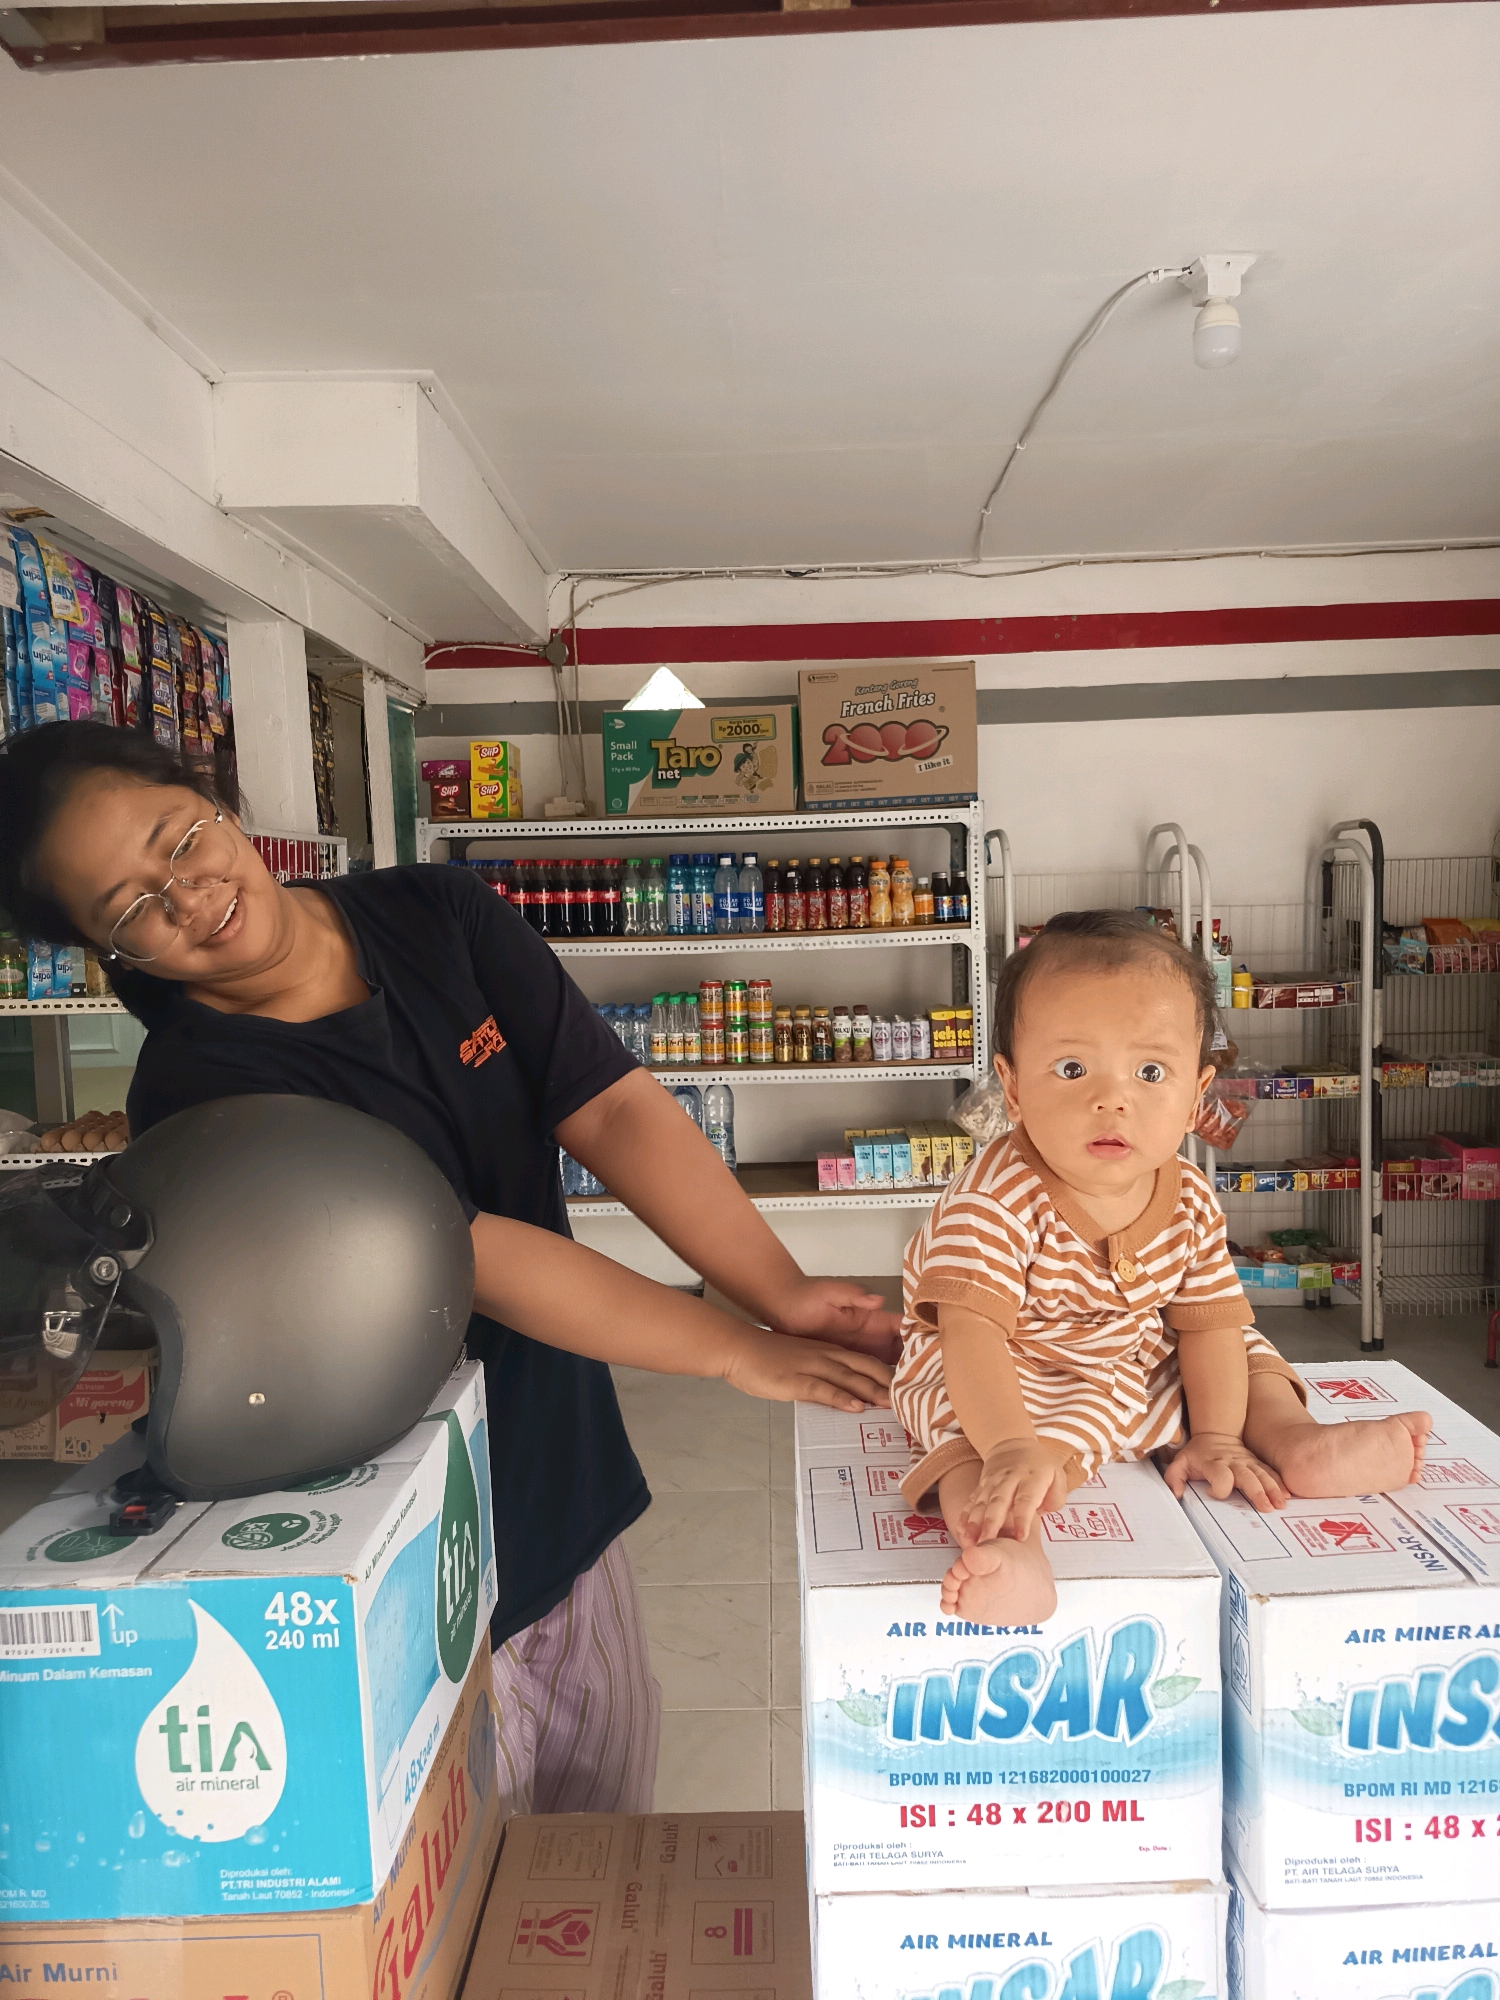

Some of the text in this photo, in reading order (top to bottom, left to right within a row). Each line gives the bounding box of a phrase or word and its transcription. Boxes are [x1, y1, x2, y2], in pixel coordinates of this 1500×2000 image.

[855, 678, 918, 696] Kentang Goreng
[840, 690, 936, 718] French Fries
[726, 723, 760, 736] 2000
[610, 741, 637, 750] Small
[821, 718, 949, 766] 2000
[611, 752, 634, 761] Pack
[651, 738, 722, 769] Taro
[924, 760, 942, 770] like
[942, 758, 951, 766] it
[657, 768, 681, 780] net
[933, 1026, 956, 1040] teh
[934, 1040, 956, 1048] kotak
[91, 1399, 135, 1410] goreng
[65, 1439, 91, 1455] 40
[838, 1468, 847, 1481] EXP
[386, 1517, 402, 1545] Dalam
[1399, 1535, 1448, 1573] INSAR
[264, 1590, 340, 1628] 48x
[456, 1590, 473, 1633] mineral
[112, 1630, 138, 1648] up
[265, 1628, 339, 1650] 240 ml
[886, 1622, 927, 1638] AIR
[1344, 1624, 1500, 1644] AIR MINERAL
[43, 1668, 86, 1681] Dalam
[90, 1666, 152, 1678] Kemasan
[890, 1615, 1160, 1748] INSAR
[1344, 1652, 1500, 1752] INS
[422, 1737, 434, 1764] 240
[176, 1775, 260, 1792] air mineral
[890, 1769, 1152, 1787] BPOM RI MD 121682000100027
[1344, 1780, 1500, 1798] BPOM RI MD 1216
[900, 1804, 936, 1828] ISI
[966, 1803, 1002, 1826] 48
[1012, 1806, 1027, 1825] x
[1037, 1800, 1092, 1824] 200
[1102, 1799, 1145, 1823] ML
[1355, 1818, 1392, 1844] ISI
[1424, 1815, 1460, 1840] 48
[1471, 1818, 1486, 1838] x
[388, 1811, 417, 1890] Murni
[660, 1821, 679, 1864] Galuh
[834, 1842, 906, 1852] Diproduksi oleh
[834, 1850, 944, 1860] PT. AIR TELAGA SURYA
[1284, 1856, 1361, 1866] Diproduksi oleh
[220, 1867, 292, 1878] Diproduksi oleh:
[1284, 1865, 1400, 1876] PT. AIR TELAGA SURYA
[1384, 1874, 1424, 1882] INDONESIA
[256, 1878, 306, 1888] INDUSTRI
[308, 1876, 341, 1886] ALAMI
[372, 1760, 468, 2000] Galuh
[31, 1890, 46, 1898] MD
[222, 1892, 250, 1901] Tanah
[252, 1891, 272, 1900] Laut
[622, 1882, 643, 1932] Galuh
[900, 1932, 1053, 1950] AIR MINERAL
[1342, 1942, 1499, 1966] AIR MINERAL
[0, 1962, 118, 1983] Air Murni
